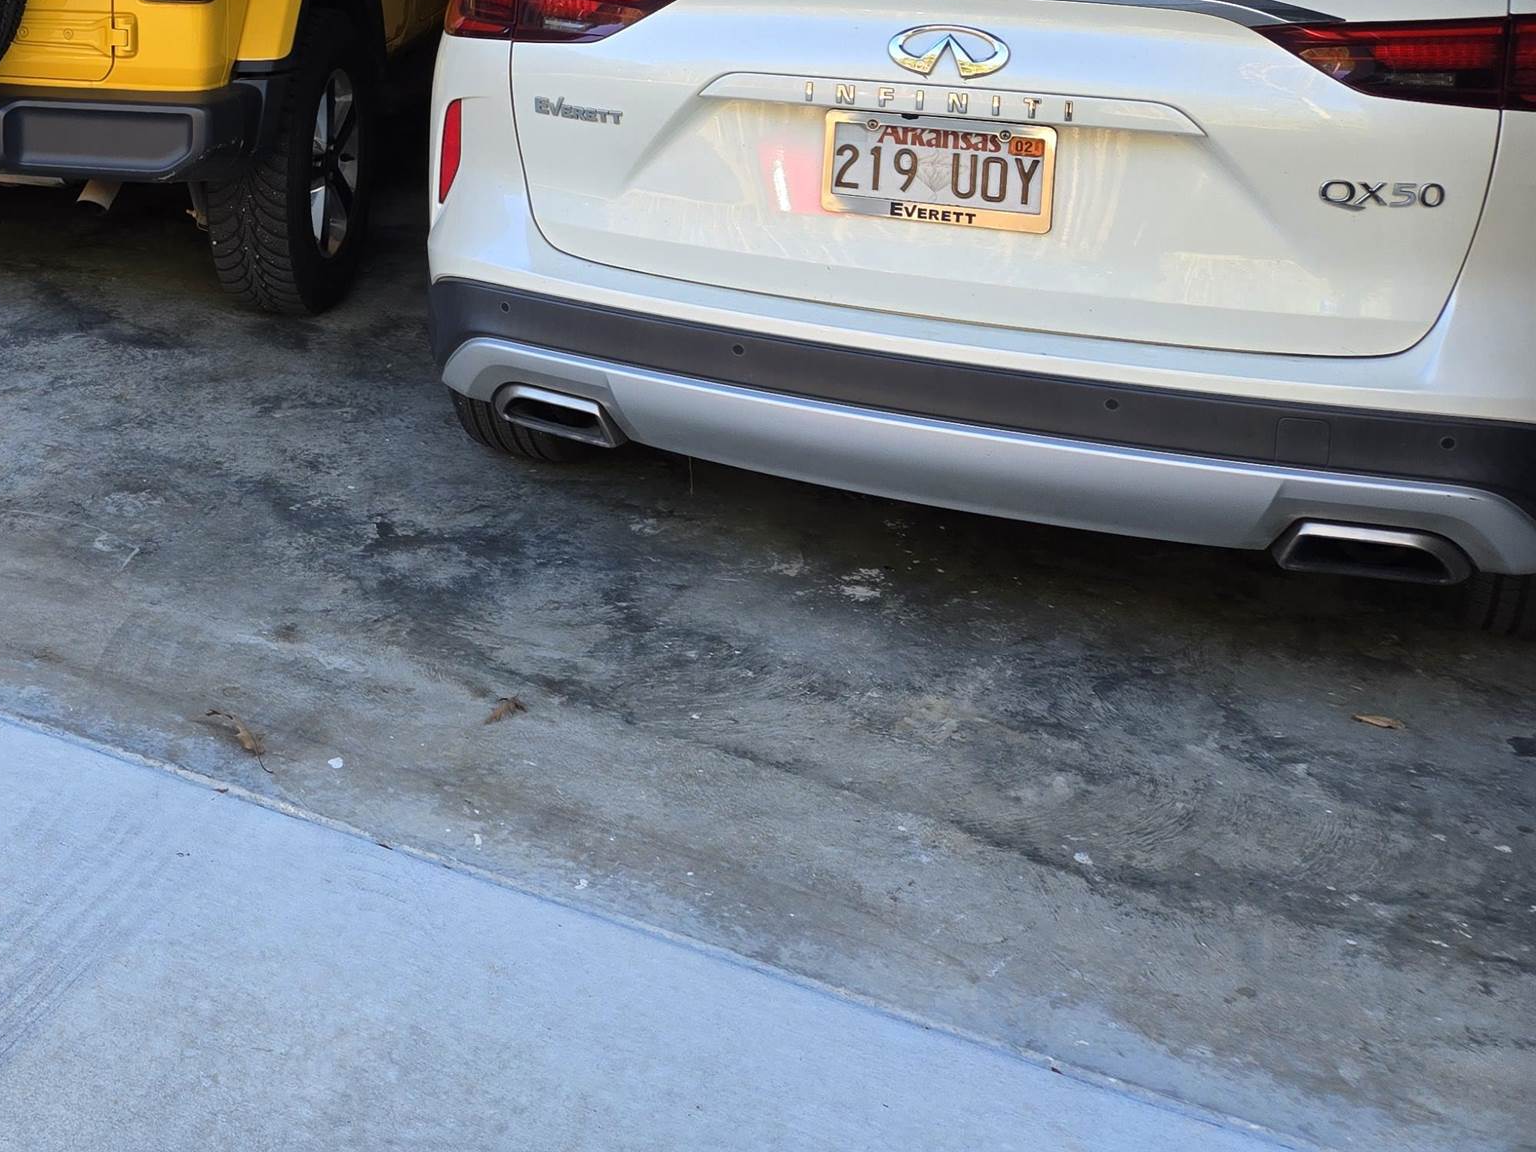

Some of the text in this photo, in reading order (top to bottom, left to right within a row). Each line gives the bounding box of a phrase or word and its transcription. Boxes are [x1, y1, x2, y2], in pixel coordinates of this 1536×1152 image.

[804, 81, 1074, 122] INFINITI
[877, 124, 1002, 153] Arkansas
[1015, 140, 1033, 153] 02
[834, 143, 1040, 205] 219 UOY
[1318, 179, 1446, 212] QX50
